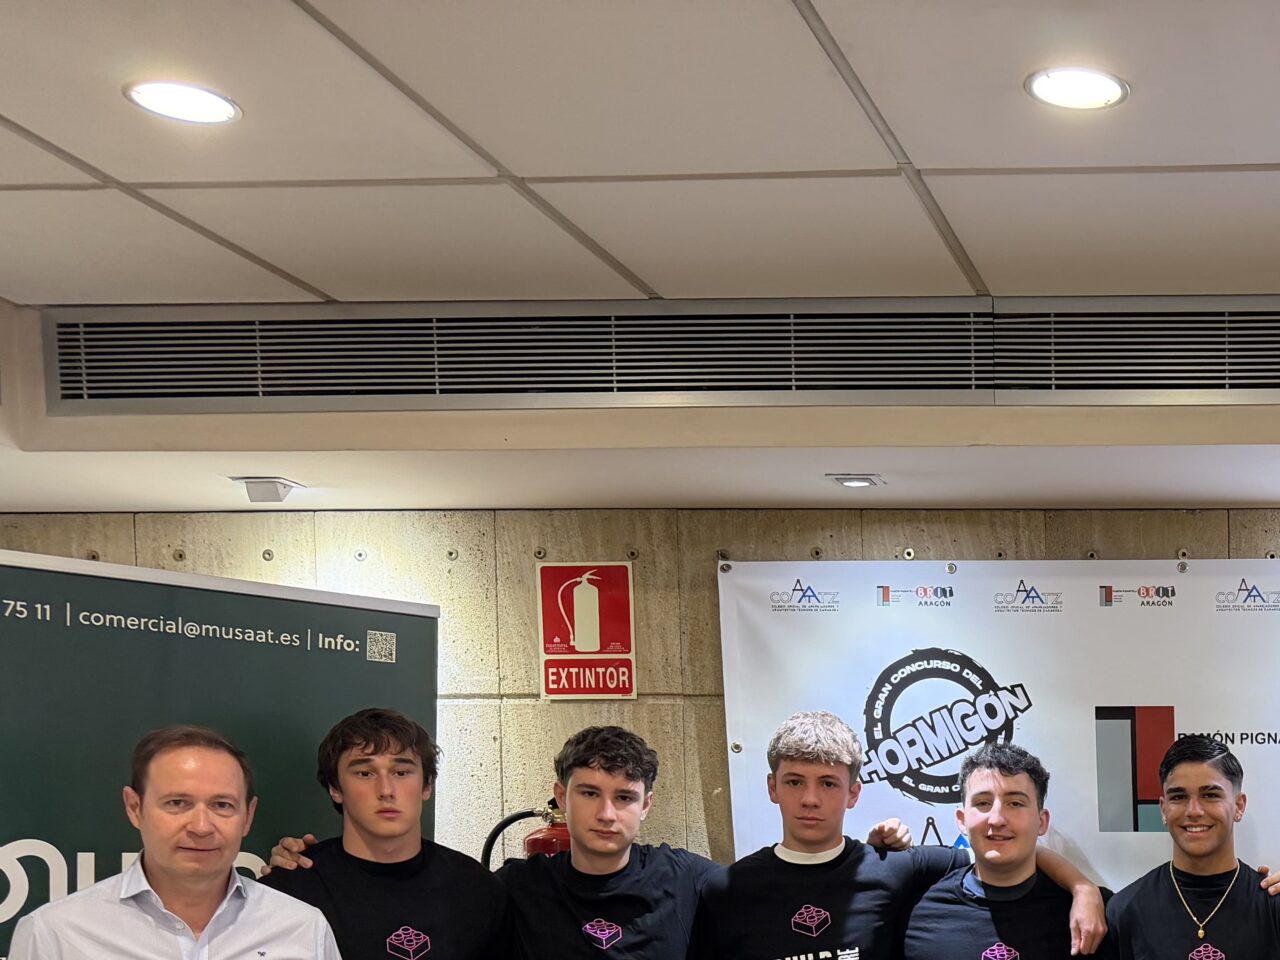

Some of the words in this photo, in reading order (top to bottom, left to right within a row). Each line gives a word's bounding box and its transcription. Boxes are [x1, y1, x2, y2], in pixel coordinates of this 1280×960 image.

[916, 586, 954, 598] BRIT
[1138, 586, 1175, 598] BRIT
[4, 600, 28, 619] 75
[35, 603, 51, 621] 11
[78, 609, 301, 647] comercial@musaat.es
[318, 633, 361, 653] Info:
[548, 666, 630, 689] EXTINTOR
[890, 659, 961, 684] CONCURSO
[962, 668, 983, 690] DEL
[873, 682, 893, 719] GRAN
[861, 686, 1031, 783] HORMIGÓN
[873, 722, 883, 739] EL
[902, 775, 916, 788] EL
[918, 785, 950, 794] GRAN
